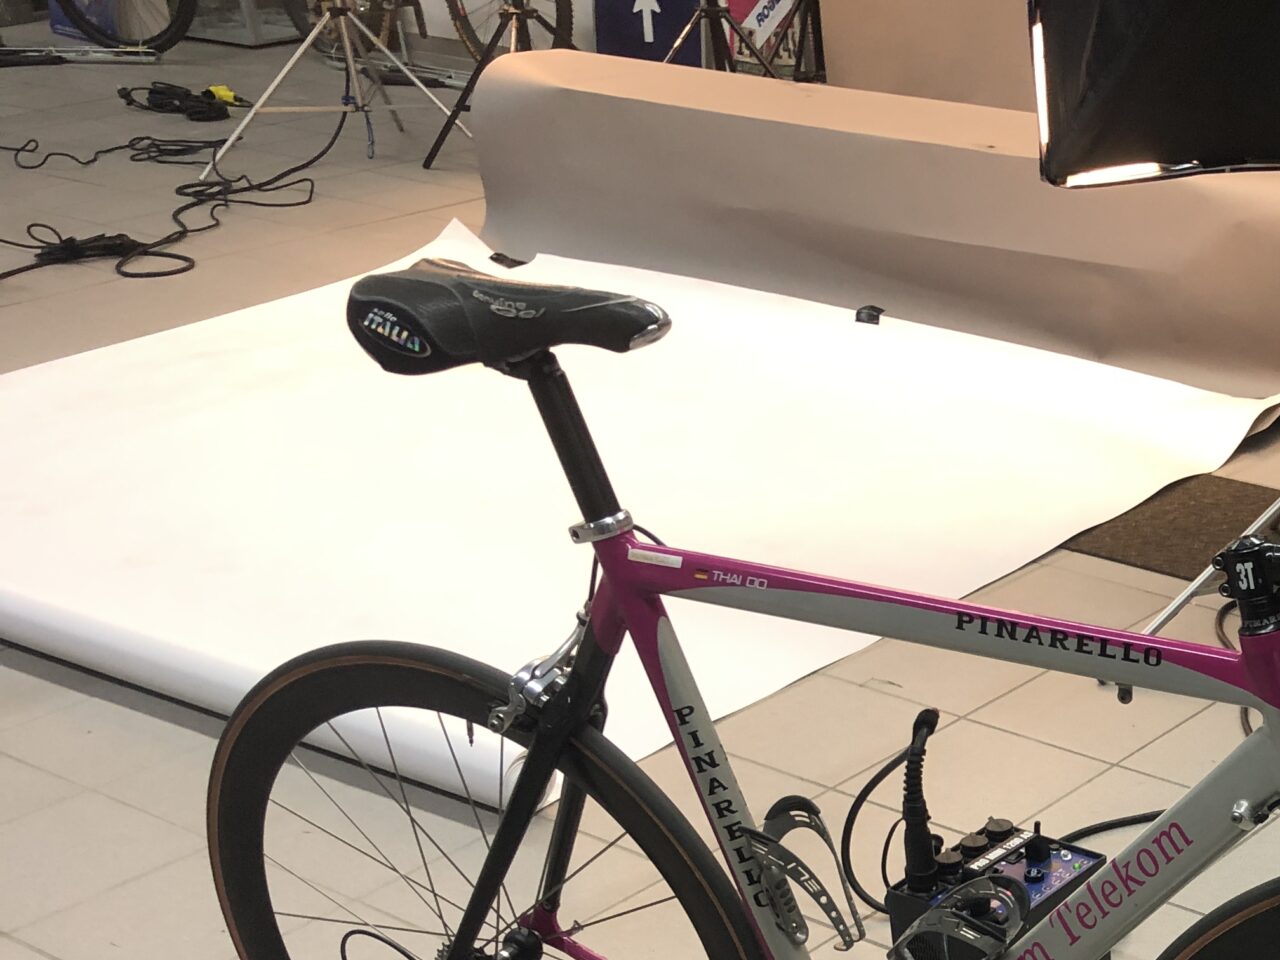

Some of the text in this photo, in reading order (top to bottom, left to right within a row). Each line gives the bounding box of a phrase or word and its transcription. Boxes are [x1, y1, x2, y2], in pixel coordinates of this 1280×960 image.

[363, 312, 421, 353] ITALIA
[1235, 560, 1256, 591] 3T
[955, 611, 1163, 667] PINARELLO
[1049, 821, 1195, 947] Telekom
